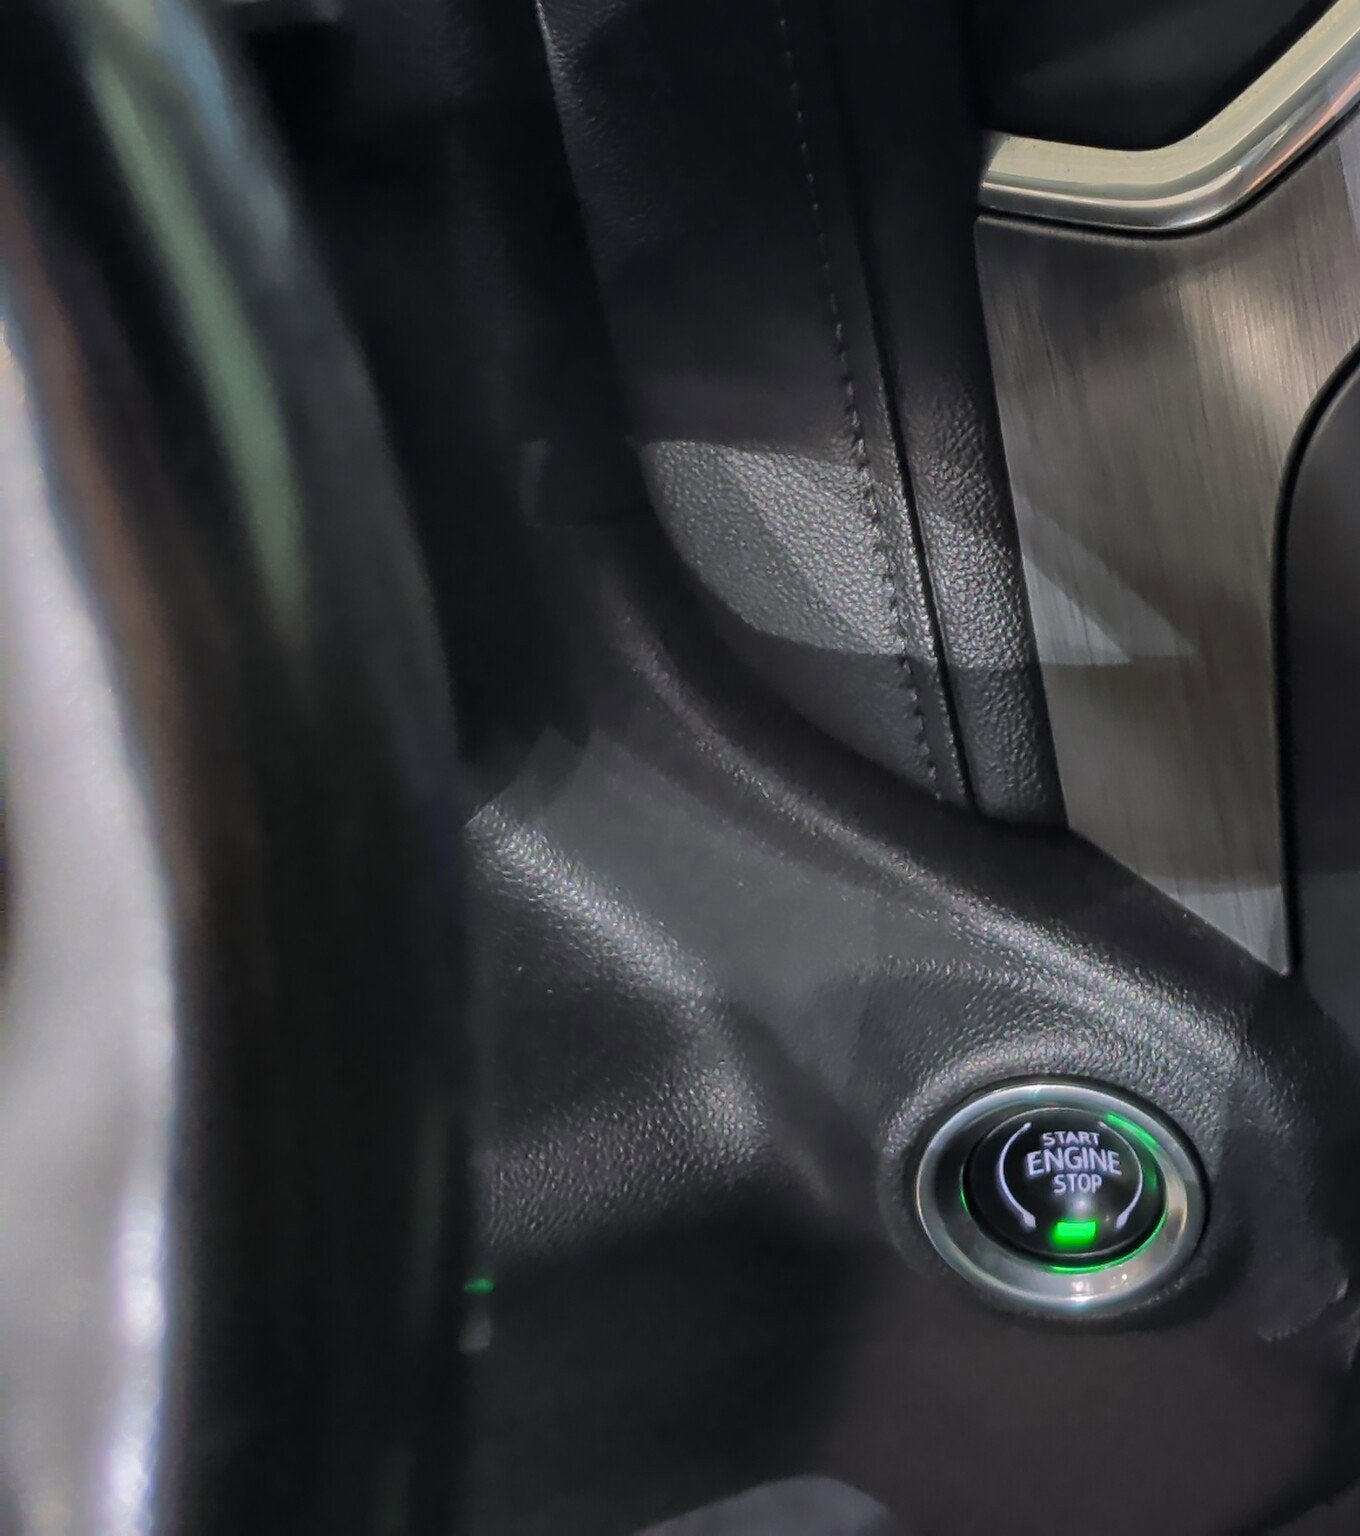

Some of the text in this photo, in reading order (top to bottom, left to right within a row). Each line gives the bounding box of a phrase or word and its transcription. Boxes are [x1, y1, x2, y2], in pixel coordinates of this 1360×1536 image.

[1041, 1130, 1101, 1146] START
[1026, 1146, 1123, 1177] ENGINE
[1053, 1172, 1102, 1194] STOP
